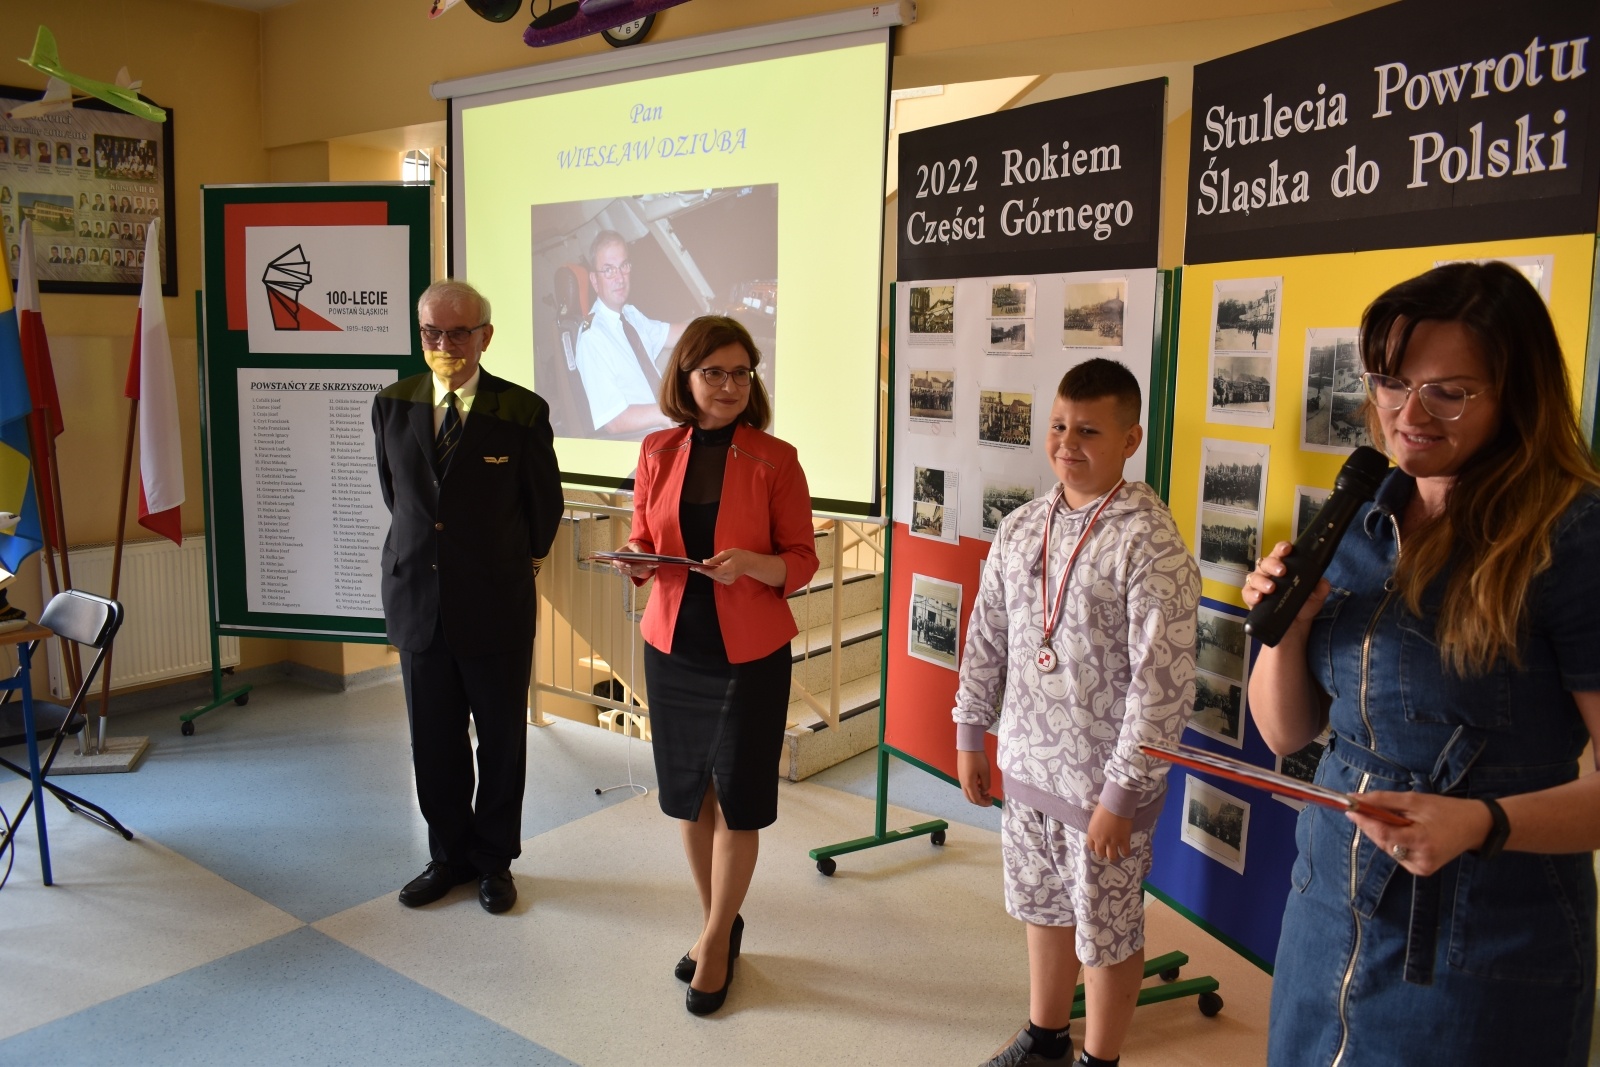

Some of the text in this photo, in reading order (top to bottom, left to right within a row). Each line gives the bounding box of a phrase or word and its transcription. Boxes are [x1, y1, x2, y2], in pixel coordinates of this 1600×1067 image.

[630, 103, 662, 124] Pan
[1202, 36, 1590, 152] Stulecia Powrotu
[557, 128, 747, 169] WIESŁAW DZIUBA
[1197, 110, 1568, 216] Śląska do Polski
[916, 141, 1122, 198] 2022 Rokiem
[906, 197, 1134, 246] Części Górnego
[326, 290, 388, 305] 100-LECIE
[328, 307, 388, 316] POWSTAŃ ŚLĄSKICH
[250, 380, 307, 390] POWSTAŃCY
[322, 383, 384, 391] SKRZYSZOWA
